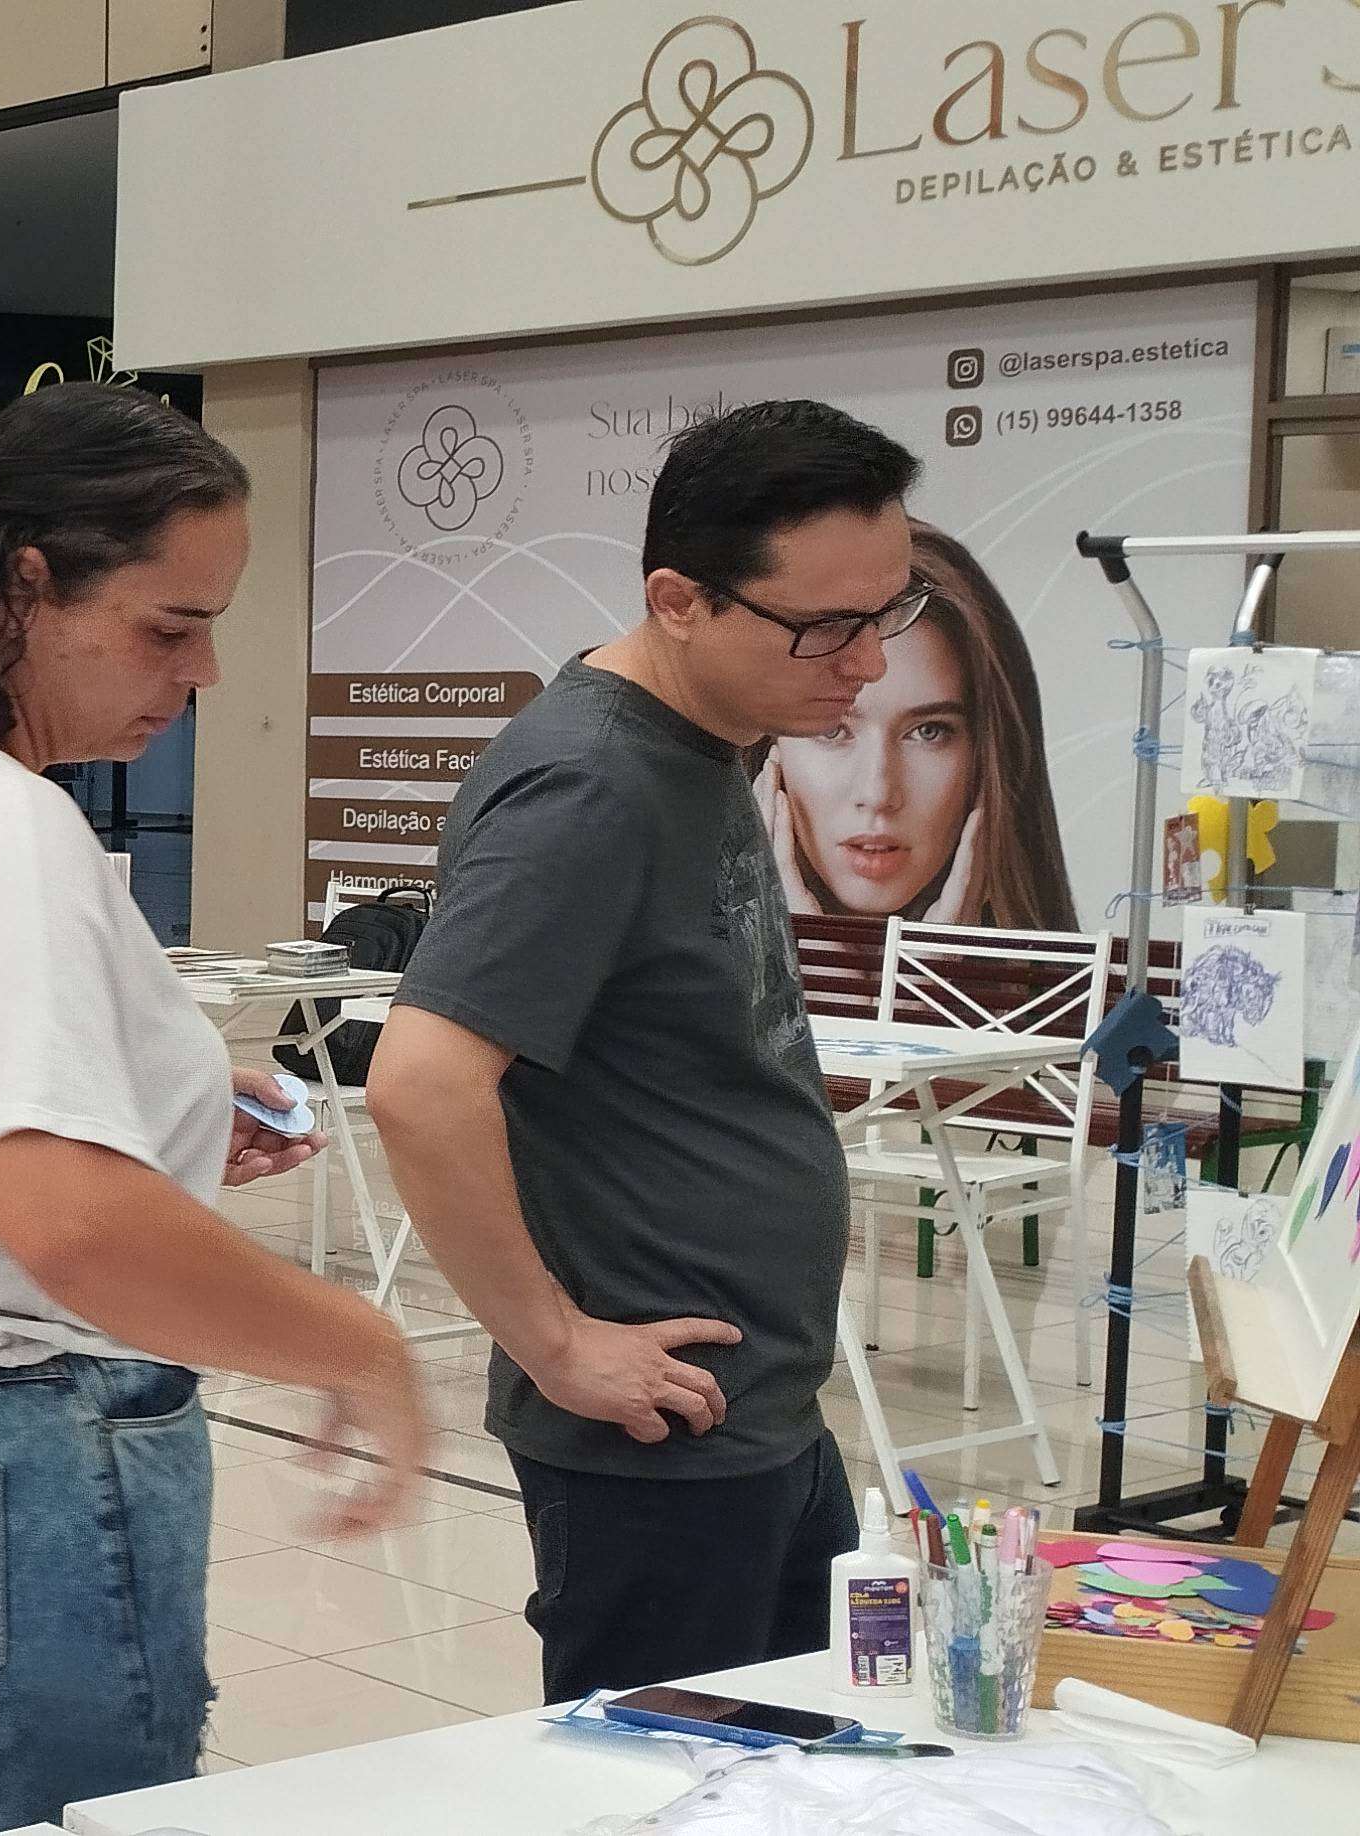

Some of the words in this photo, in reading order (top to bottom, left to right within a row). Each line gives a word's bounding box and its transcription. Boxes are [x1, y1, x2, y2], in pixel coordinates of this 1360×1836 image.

[836, 0, 1287, 161] Laser
[895, 151, 1097, 204] DEPILAÇÃO
[1116, 150, 1140, 176] &
[1160, 123, 1352, 172] ESTÉTICA
[998, 338, 1230, 378] @laserspa.estetica
[587, 400, 652, 440] Sua
[995, 408, 1039, 436] (15)
[1046, 400, 1183, 430] 99644-1358
[348, 682, 420, 703] Estética
[425, 681, 506, 707] Corporal
[359, 747, 431, 768] Estética
[342, 807, 431, 835] Depilação
